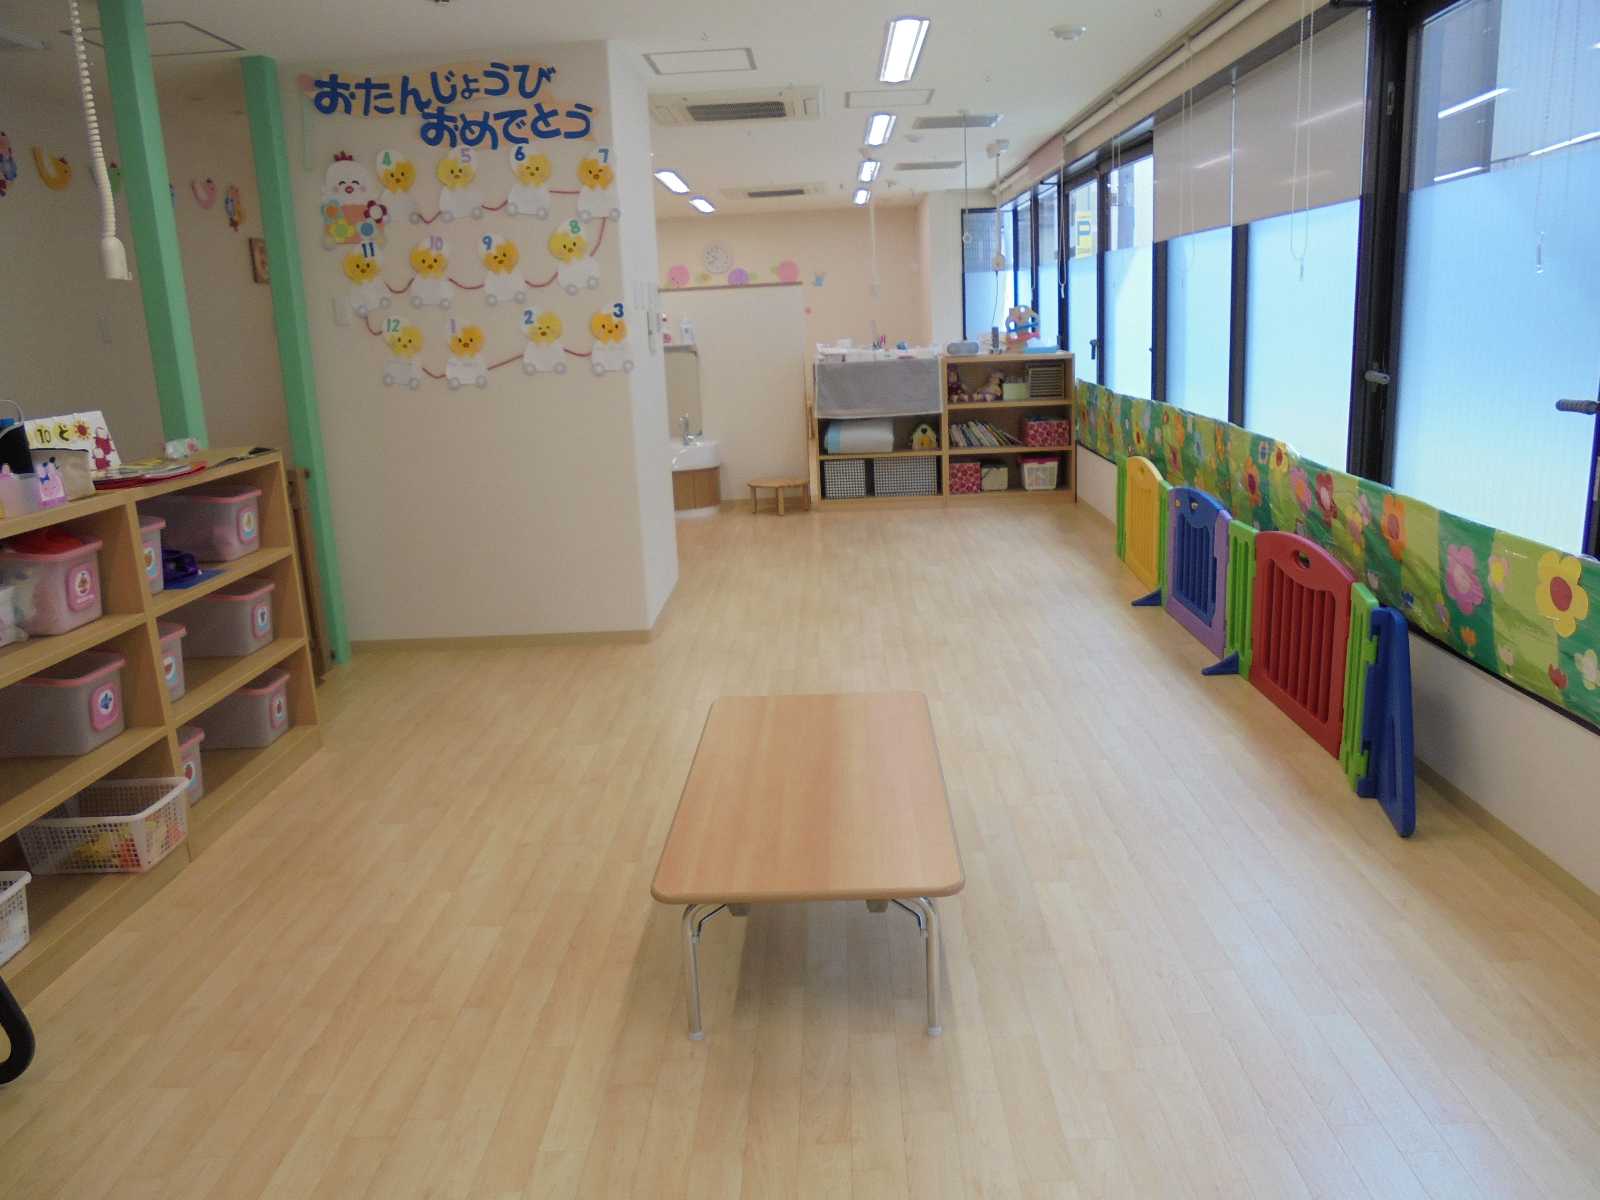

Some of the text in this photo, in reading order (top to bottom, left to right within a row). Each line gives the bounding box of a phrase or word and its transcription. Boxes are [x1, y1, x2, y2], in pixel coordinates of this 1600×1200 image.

[313, 62, 556, 116] おたんじょうび
[420, 103, 593, 150] おめでとう
[382, 152, 392, 166] 4
[461, 148, 472, 164] 5
[514, 147, 526, 161] 6
[598, 148, 610, 163] 7
[569, 220, 581, 234] 8
[361, 242, 375, 257] 11
[429, 236, 444, 249] 10
[482, 236, 493, 250] 9
[524, 310, 533, 325] 2
[613, 303, 624, 318] 3
[386, 318, 400, 332] 12
